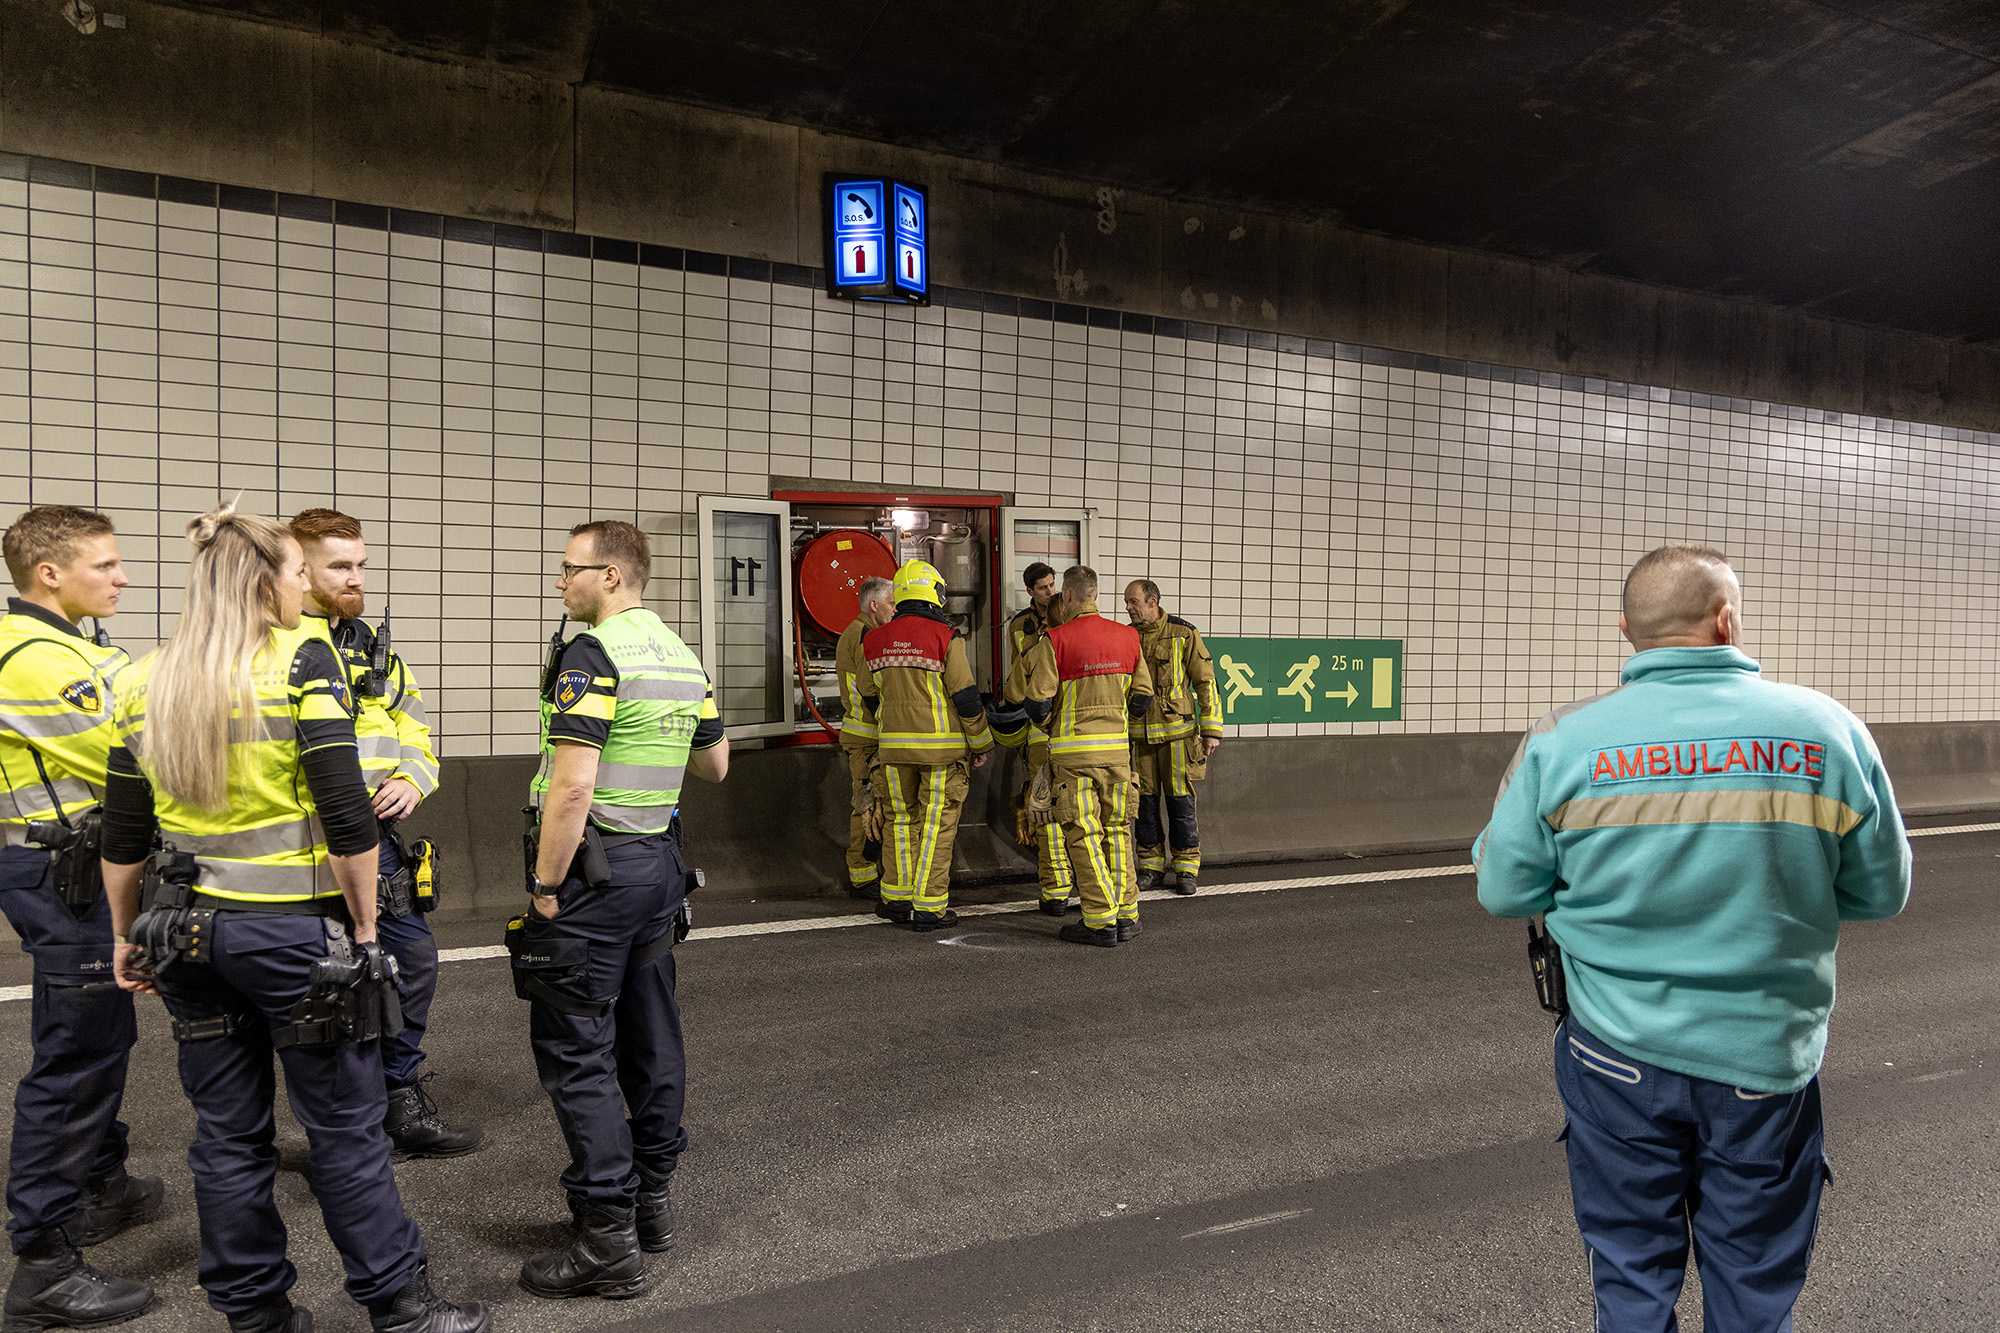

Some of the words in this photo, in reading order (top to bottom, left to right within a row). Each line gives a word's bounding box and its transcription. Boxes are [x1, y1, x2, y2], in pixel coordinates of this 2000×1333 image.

[844, 214, 865, 222] S.O.S.
[900, 217, 914, 228] S.O.S.
[893, 641, 911, 649] Stage
[1084, 662, 1121, 671] Bevelvoerder
[1331, 655, 1347, 671] 25
[1352, 658, 1363, 671] m
[1593, 741, 1823, 781] AMBULANCE
